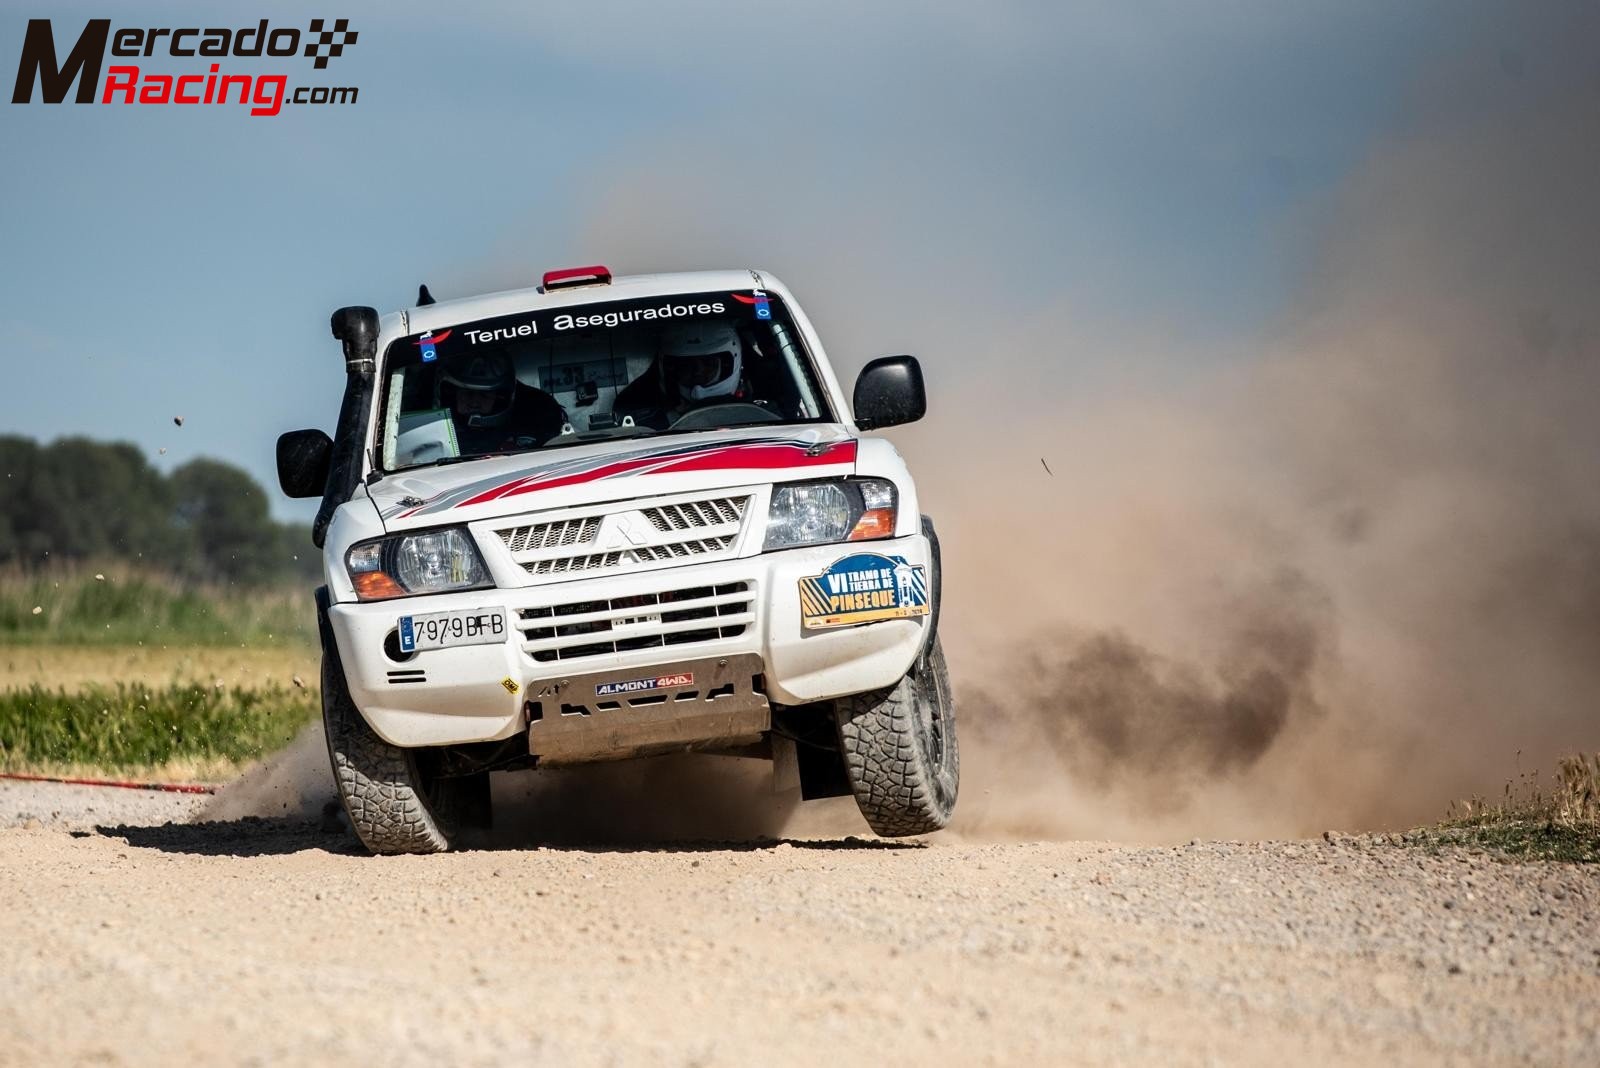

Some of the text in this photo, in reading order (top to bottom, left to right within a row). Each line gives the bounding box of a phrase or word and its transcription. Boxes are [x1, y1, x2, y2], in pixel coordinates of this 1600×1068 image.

[464, 321, 538, 345] Teruel
[848, 567, 892, 582] TRAMO DE
[827, 573, 848, 594] VI
[849, 577, 894, 592] TIERRA DE
[830, 589, 896, 612] PINSEQUE
[404, 635, 412, 645] E
[598, 679, 657, 695] ALMONT
